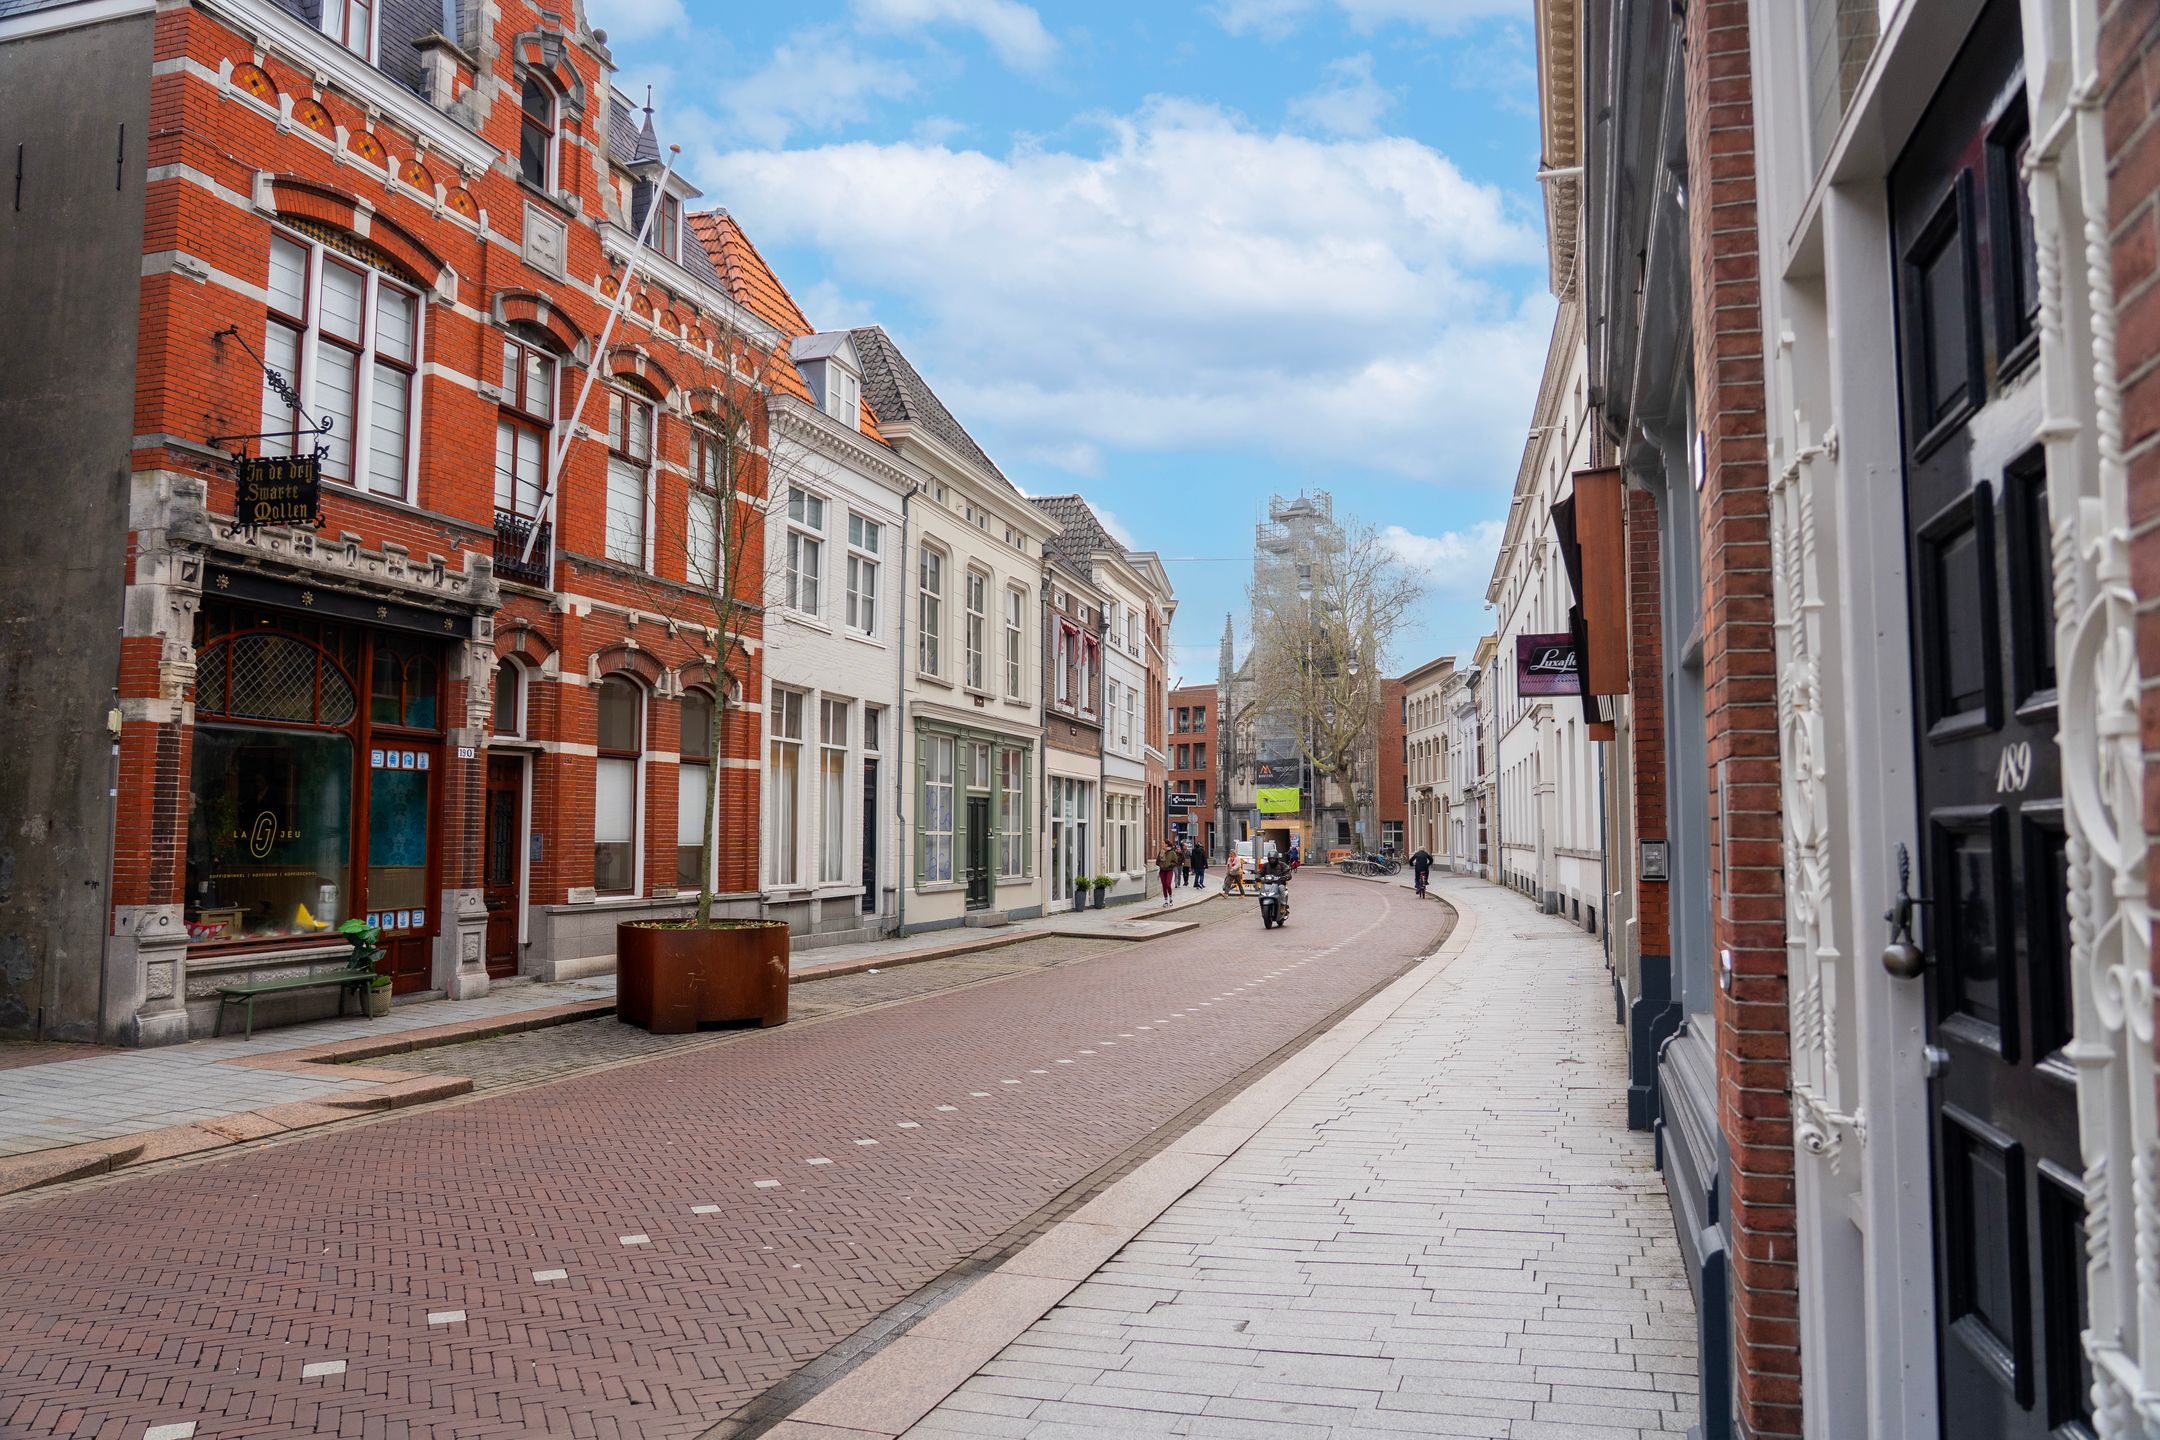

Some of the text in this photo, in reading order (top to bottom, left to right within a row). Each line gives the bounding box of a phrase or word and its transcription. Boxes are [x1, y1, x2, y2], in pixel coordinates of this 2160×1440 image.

[247, 464, 263, 481] In
[269, 463, 283, 480] de
[245, 483, 299, 501] Swarte
[460, 748, 472, 758] 190
[1996, 741, 2031, 792] 189
[233, 830, 247, 838] LA
[280, 830, 301, 838] JEU
